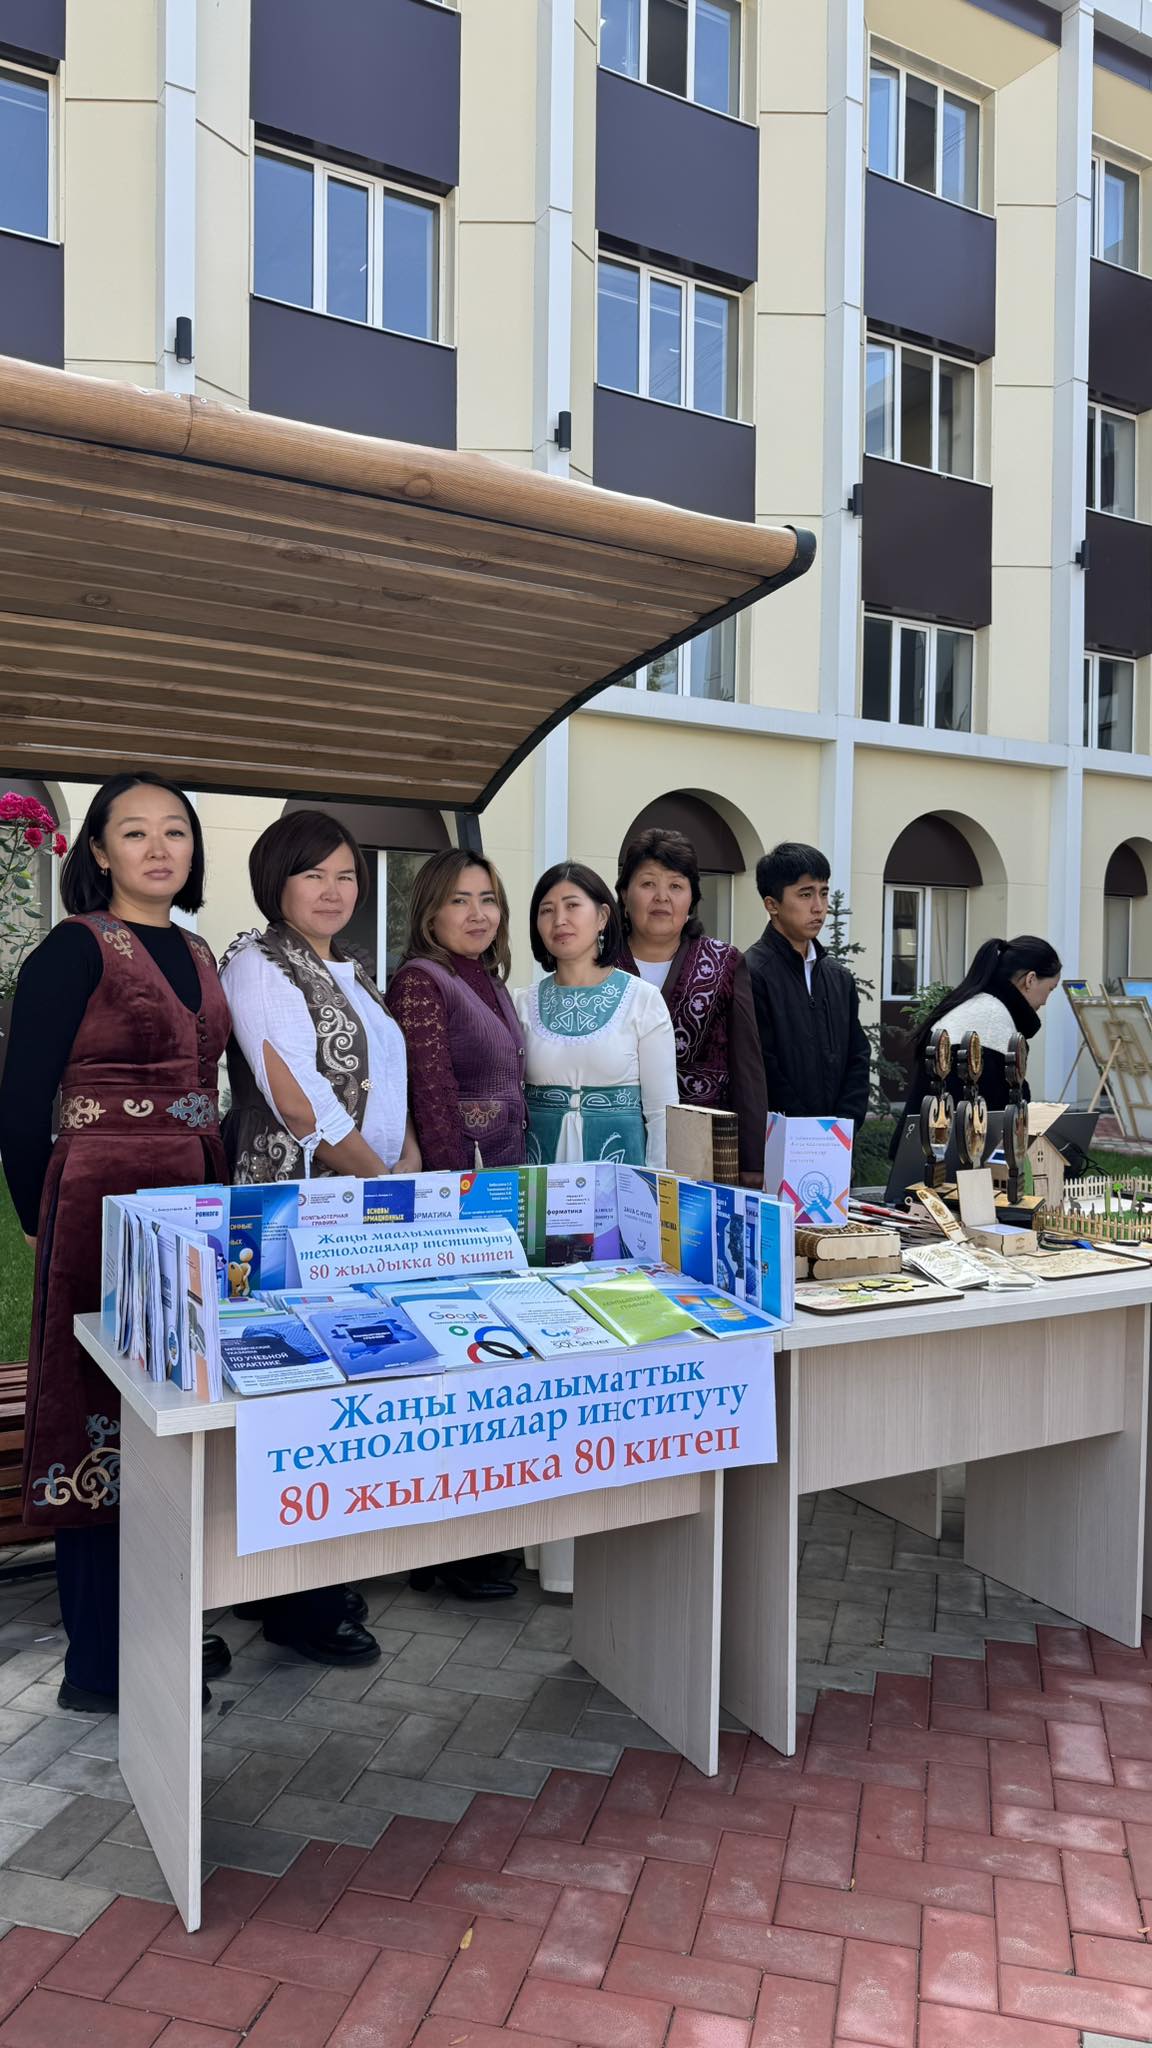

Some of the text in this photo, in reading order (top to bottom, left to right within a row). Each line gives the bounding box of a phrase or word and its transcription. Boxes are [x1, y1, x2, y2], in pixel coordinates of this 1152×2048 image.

[301, 1213, 349, 1221] КОМПЬЮТЕРНАЯ
[300, 1234, 513, 1261] технологиялар институту
[317, 1226, 489, 1246] Жаңы маалыматтык
[309, 1250, 515, 1281] 80 жылдыкка 80 китеп
[429, 1311, 488, 1320] Google
[232, 1360, 282, 1369] ПРАКТИКЕ
[245, 1352, 289, 1362] УЧЕБНОЙ
[328, 1360, 705, 1432] Жаңы маалыматтык
[267, 1383, 749, 1474] технологиялар институту
[279, 1426, 741, 1526] 80 жылдыка 80 китеп
